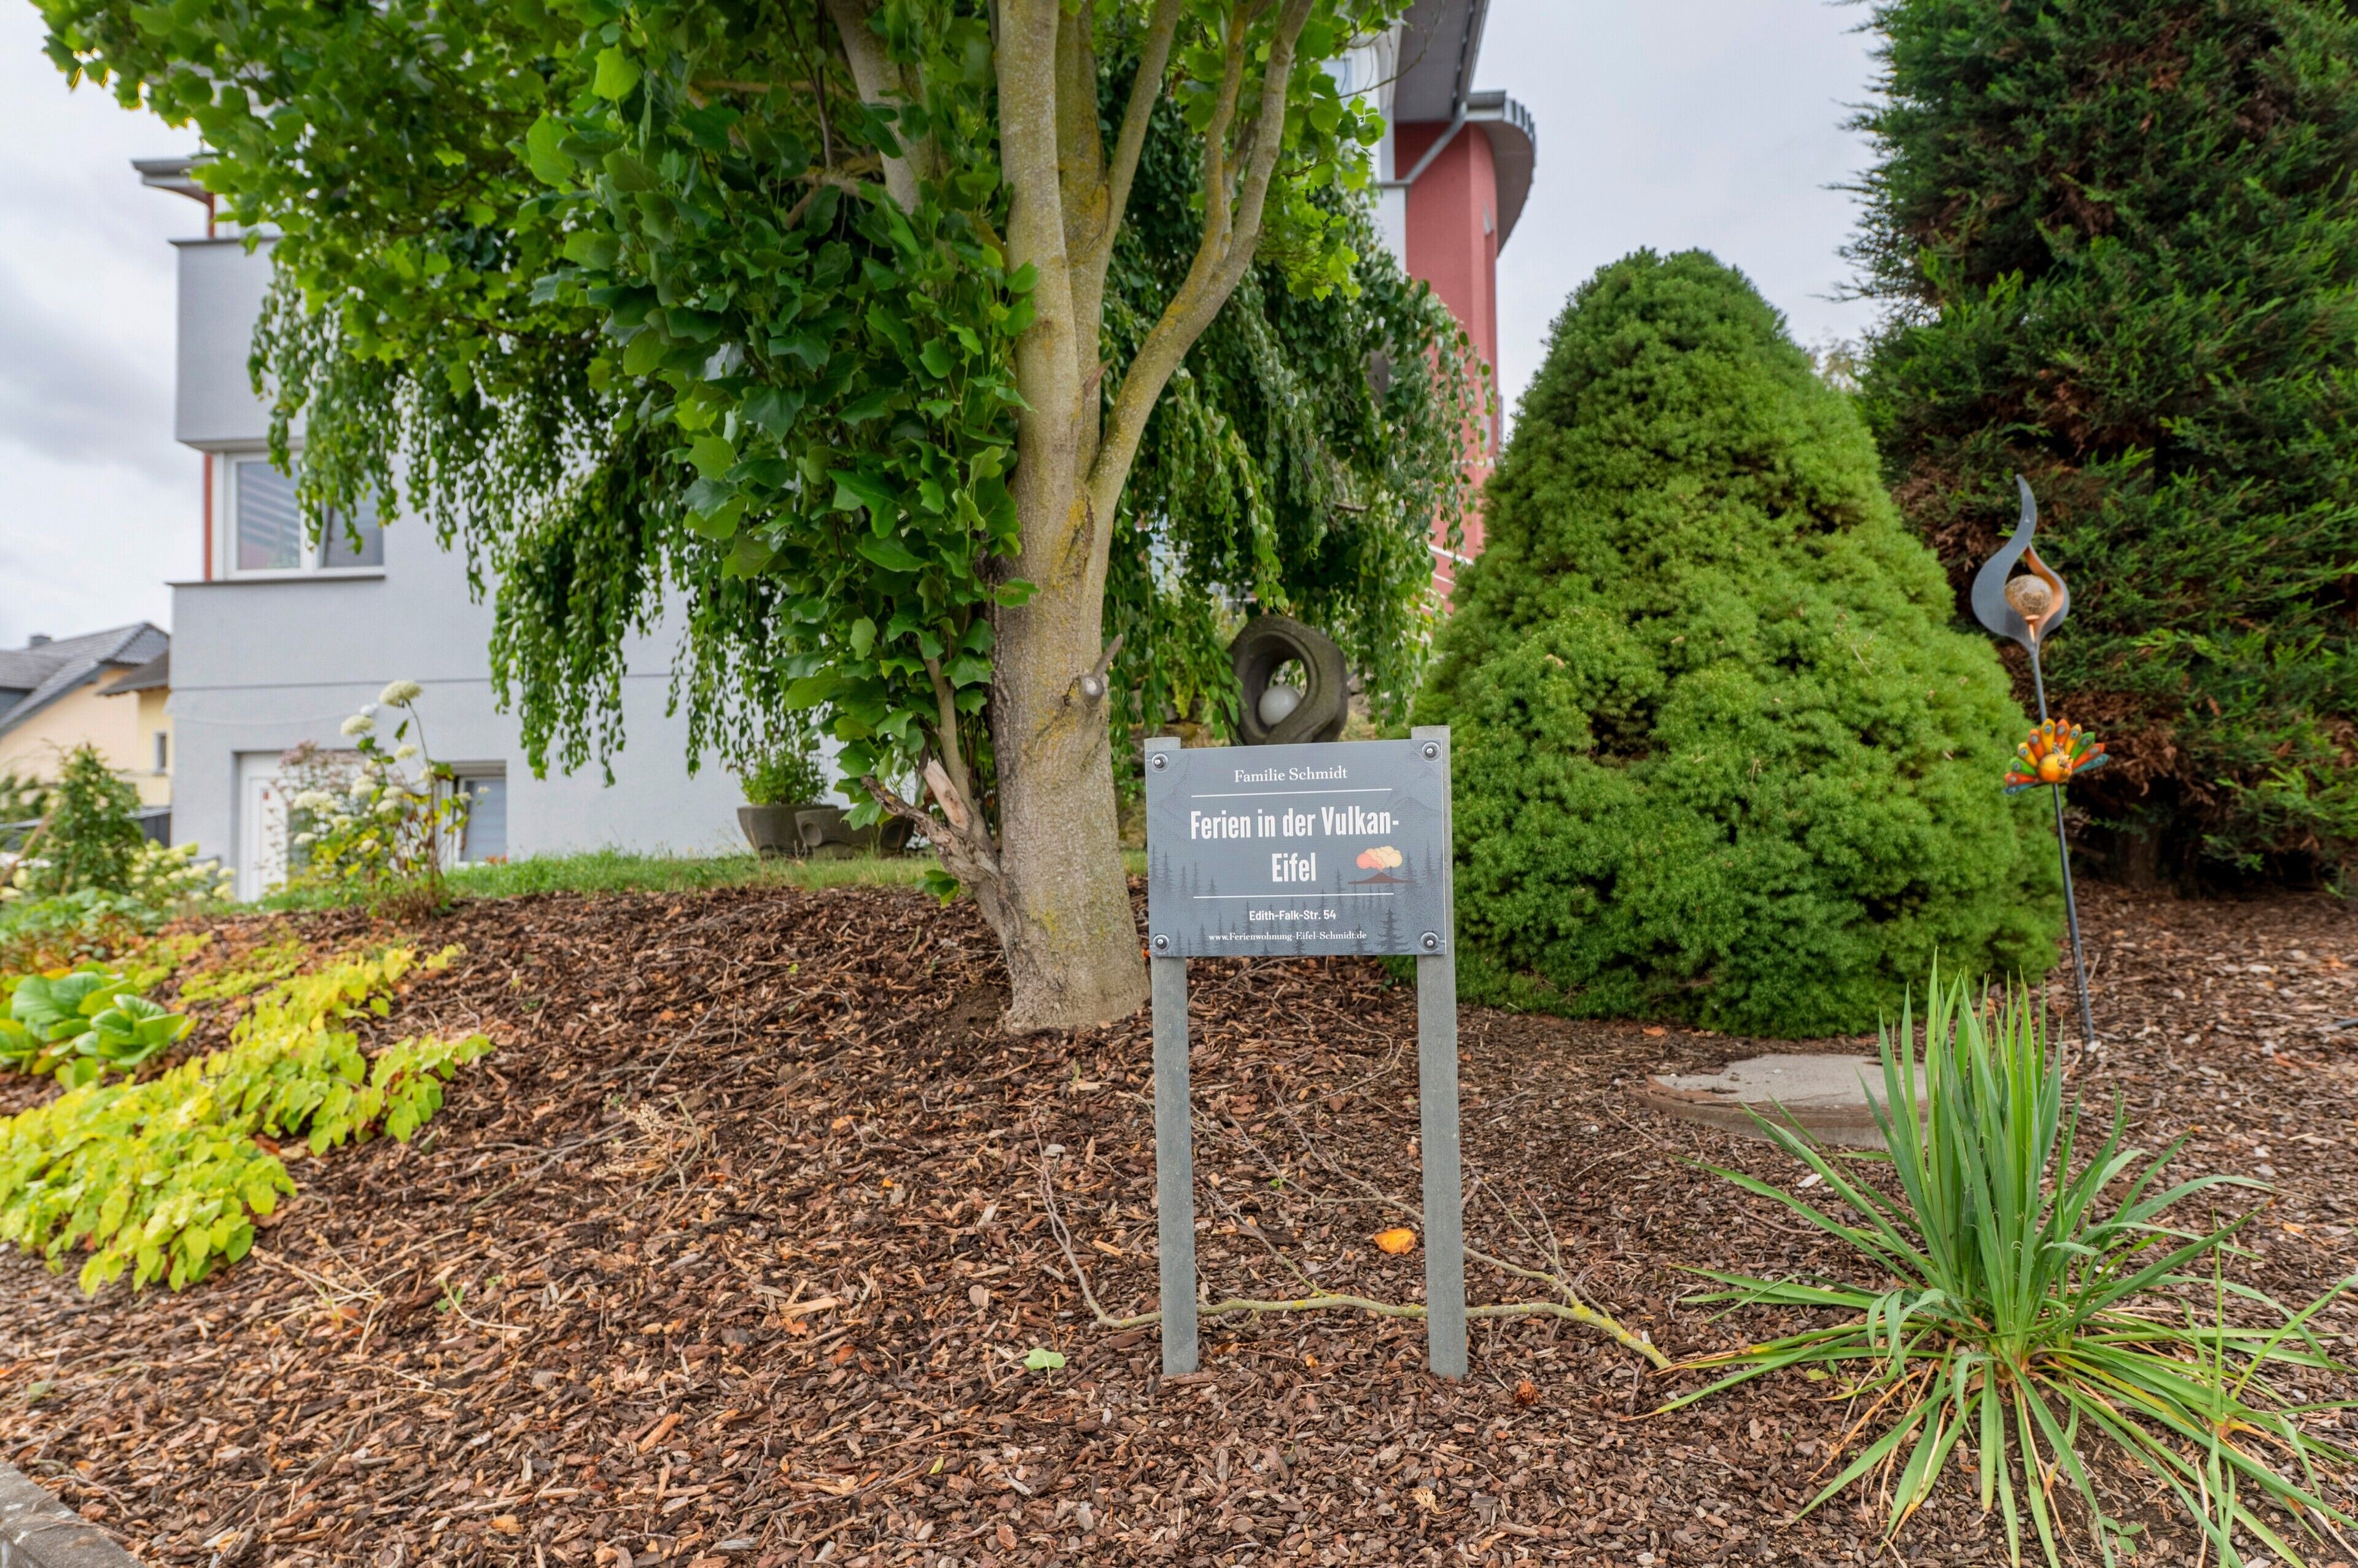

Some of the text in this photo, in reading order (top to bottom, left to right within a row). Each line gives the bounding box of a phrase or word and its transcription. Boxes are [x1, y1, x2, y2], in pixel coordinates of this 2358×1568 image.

[1234, 766, 1348, 782] Familie Schmidt
[1190, 805, 1399, 839] Ferien in der Vulkan-
[1272, 852, 1316, 882] Eifel
[1249, 909, 1336, 921] Edith-Falk-Str. 54
[1208, 931, 1367, 941] www.Ferienwohnung-Eifel-Schmidt.de
